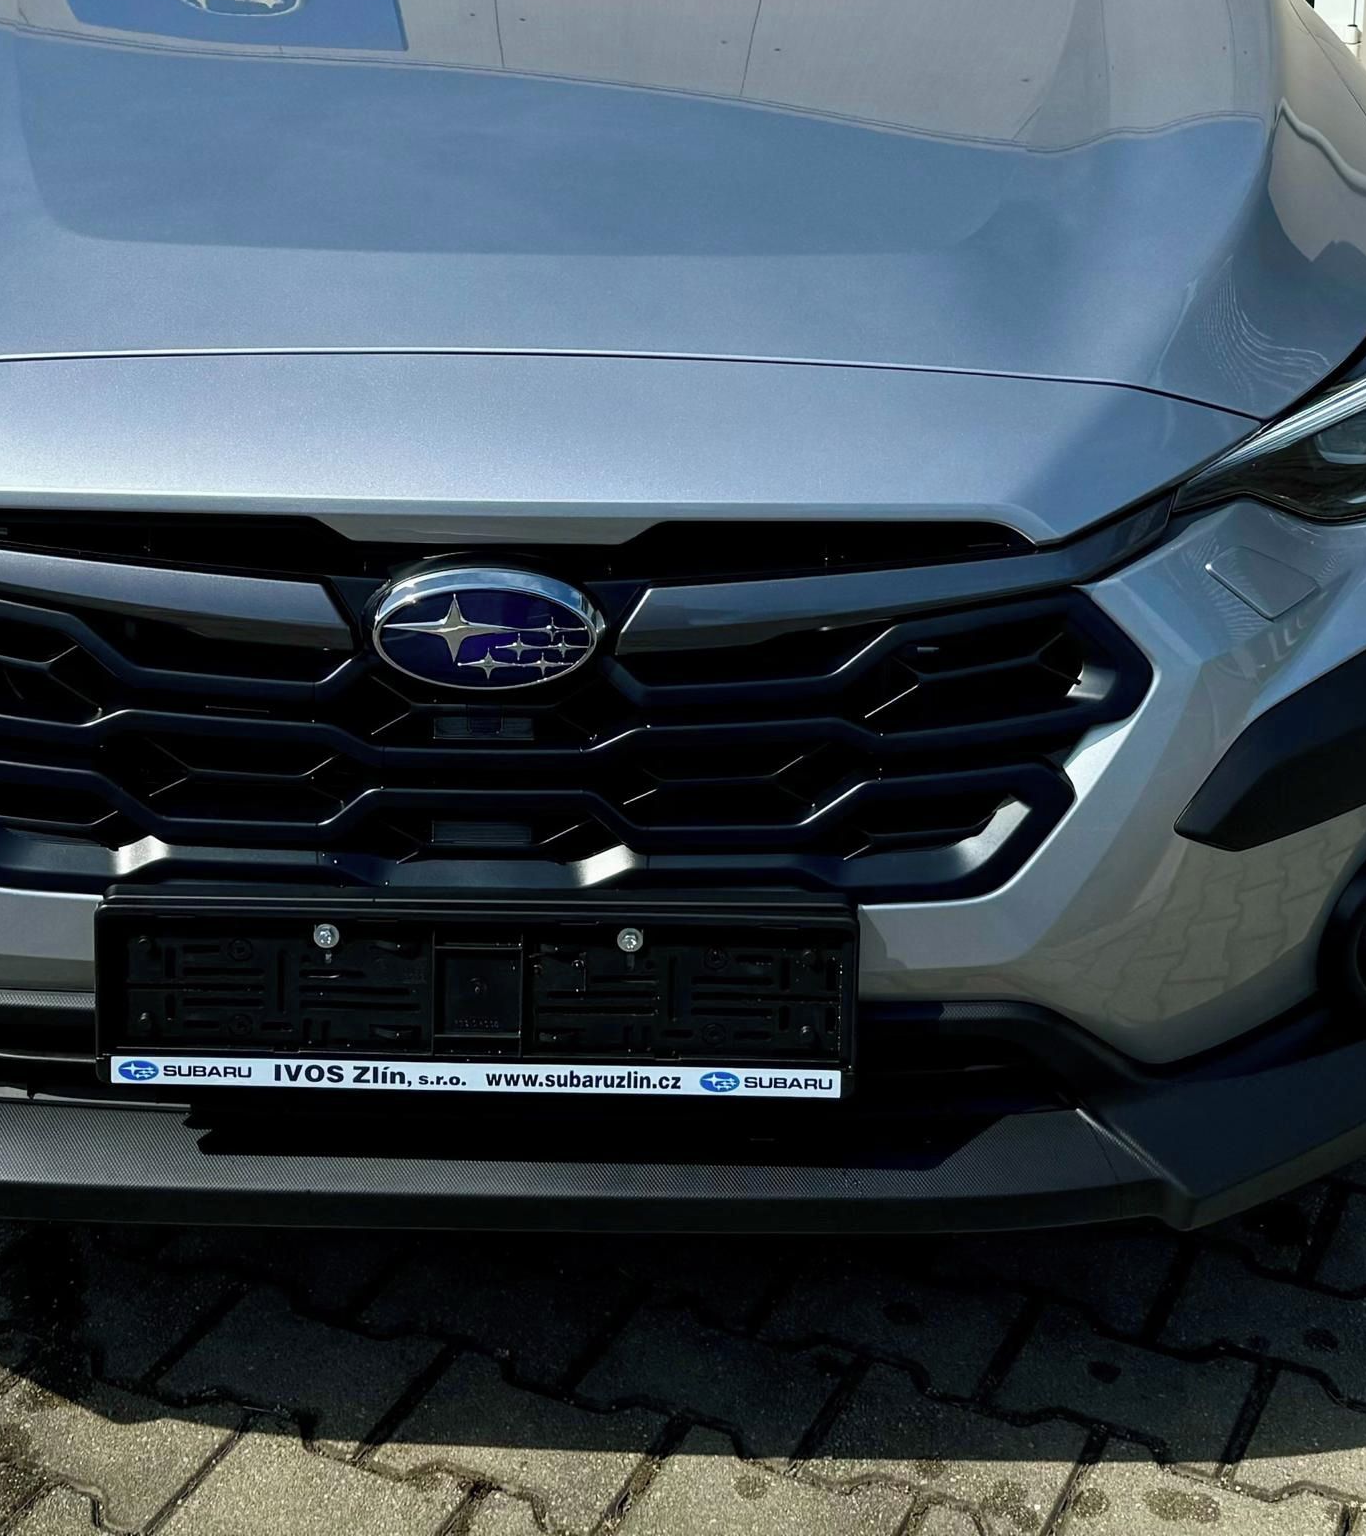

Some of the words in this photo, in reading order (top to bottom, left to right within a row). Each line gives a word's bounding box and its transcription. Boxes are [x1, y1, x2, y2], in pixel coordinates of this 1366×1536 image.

[162, 1064, 252, 1079] SUBARU
[274, 1064, 345, 1083] IVOS
[352, 1065, 412, 1087] Zlín,
[418, 1074, 467, 1086] s.r.o.
[485, 1069, 682, 1090] www.subaruzlin.cz
[744, 1075, 833, 1091] SUBARU
